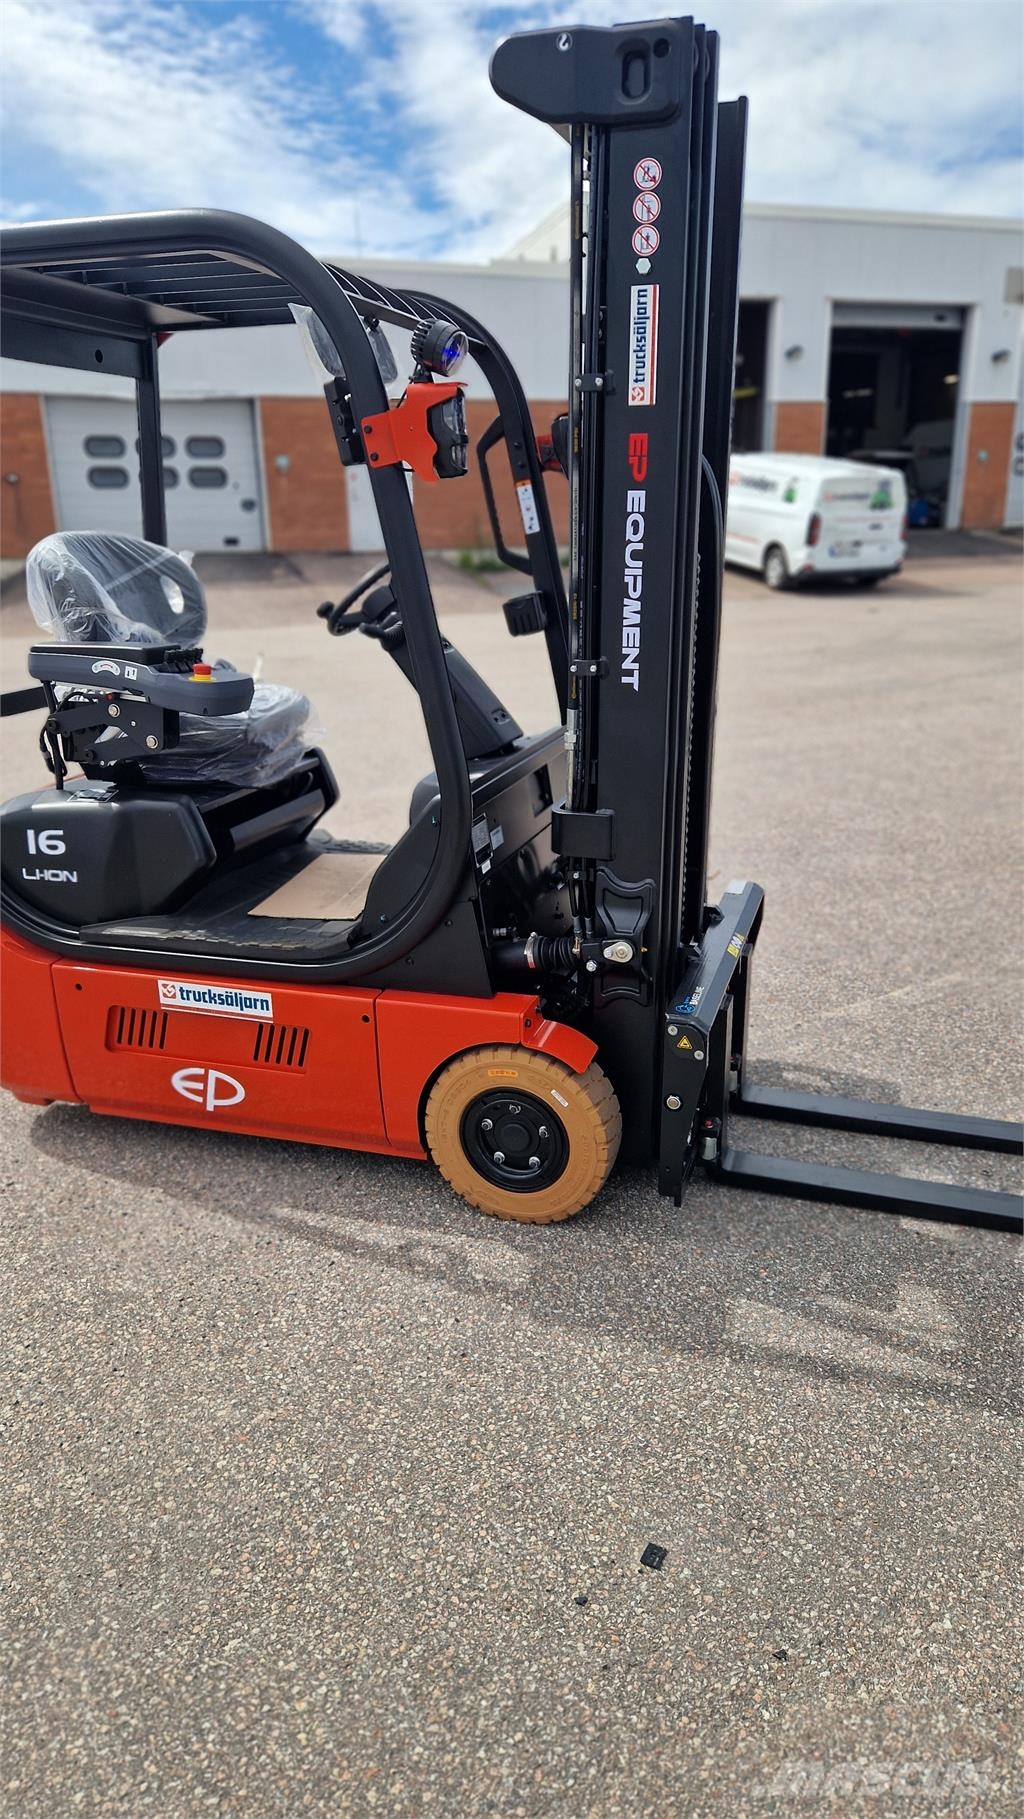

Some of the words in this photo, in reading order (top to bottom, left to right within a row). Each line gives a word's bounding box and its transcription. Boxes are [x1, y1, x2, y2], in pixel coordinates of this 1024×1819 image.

[633, 288, 650, 383] trucksäljarn
[628, 433, 648, 482] EP
[621, 490, 646, 692] EQUIPMENT
[26, 829, 66, 855] 16
[179, 986, 270, 1011] trucksäljarn
[171, 1067, 245, 1111] EP
